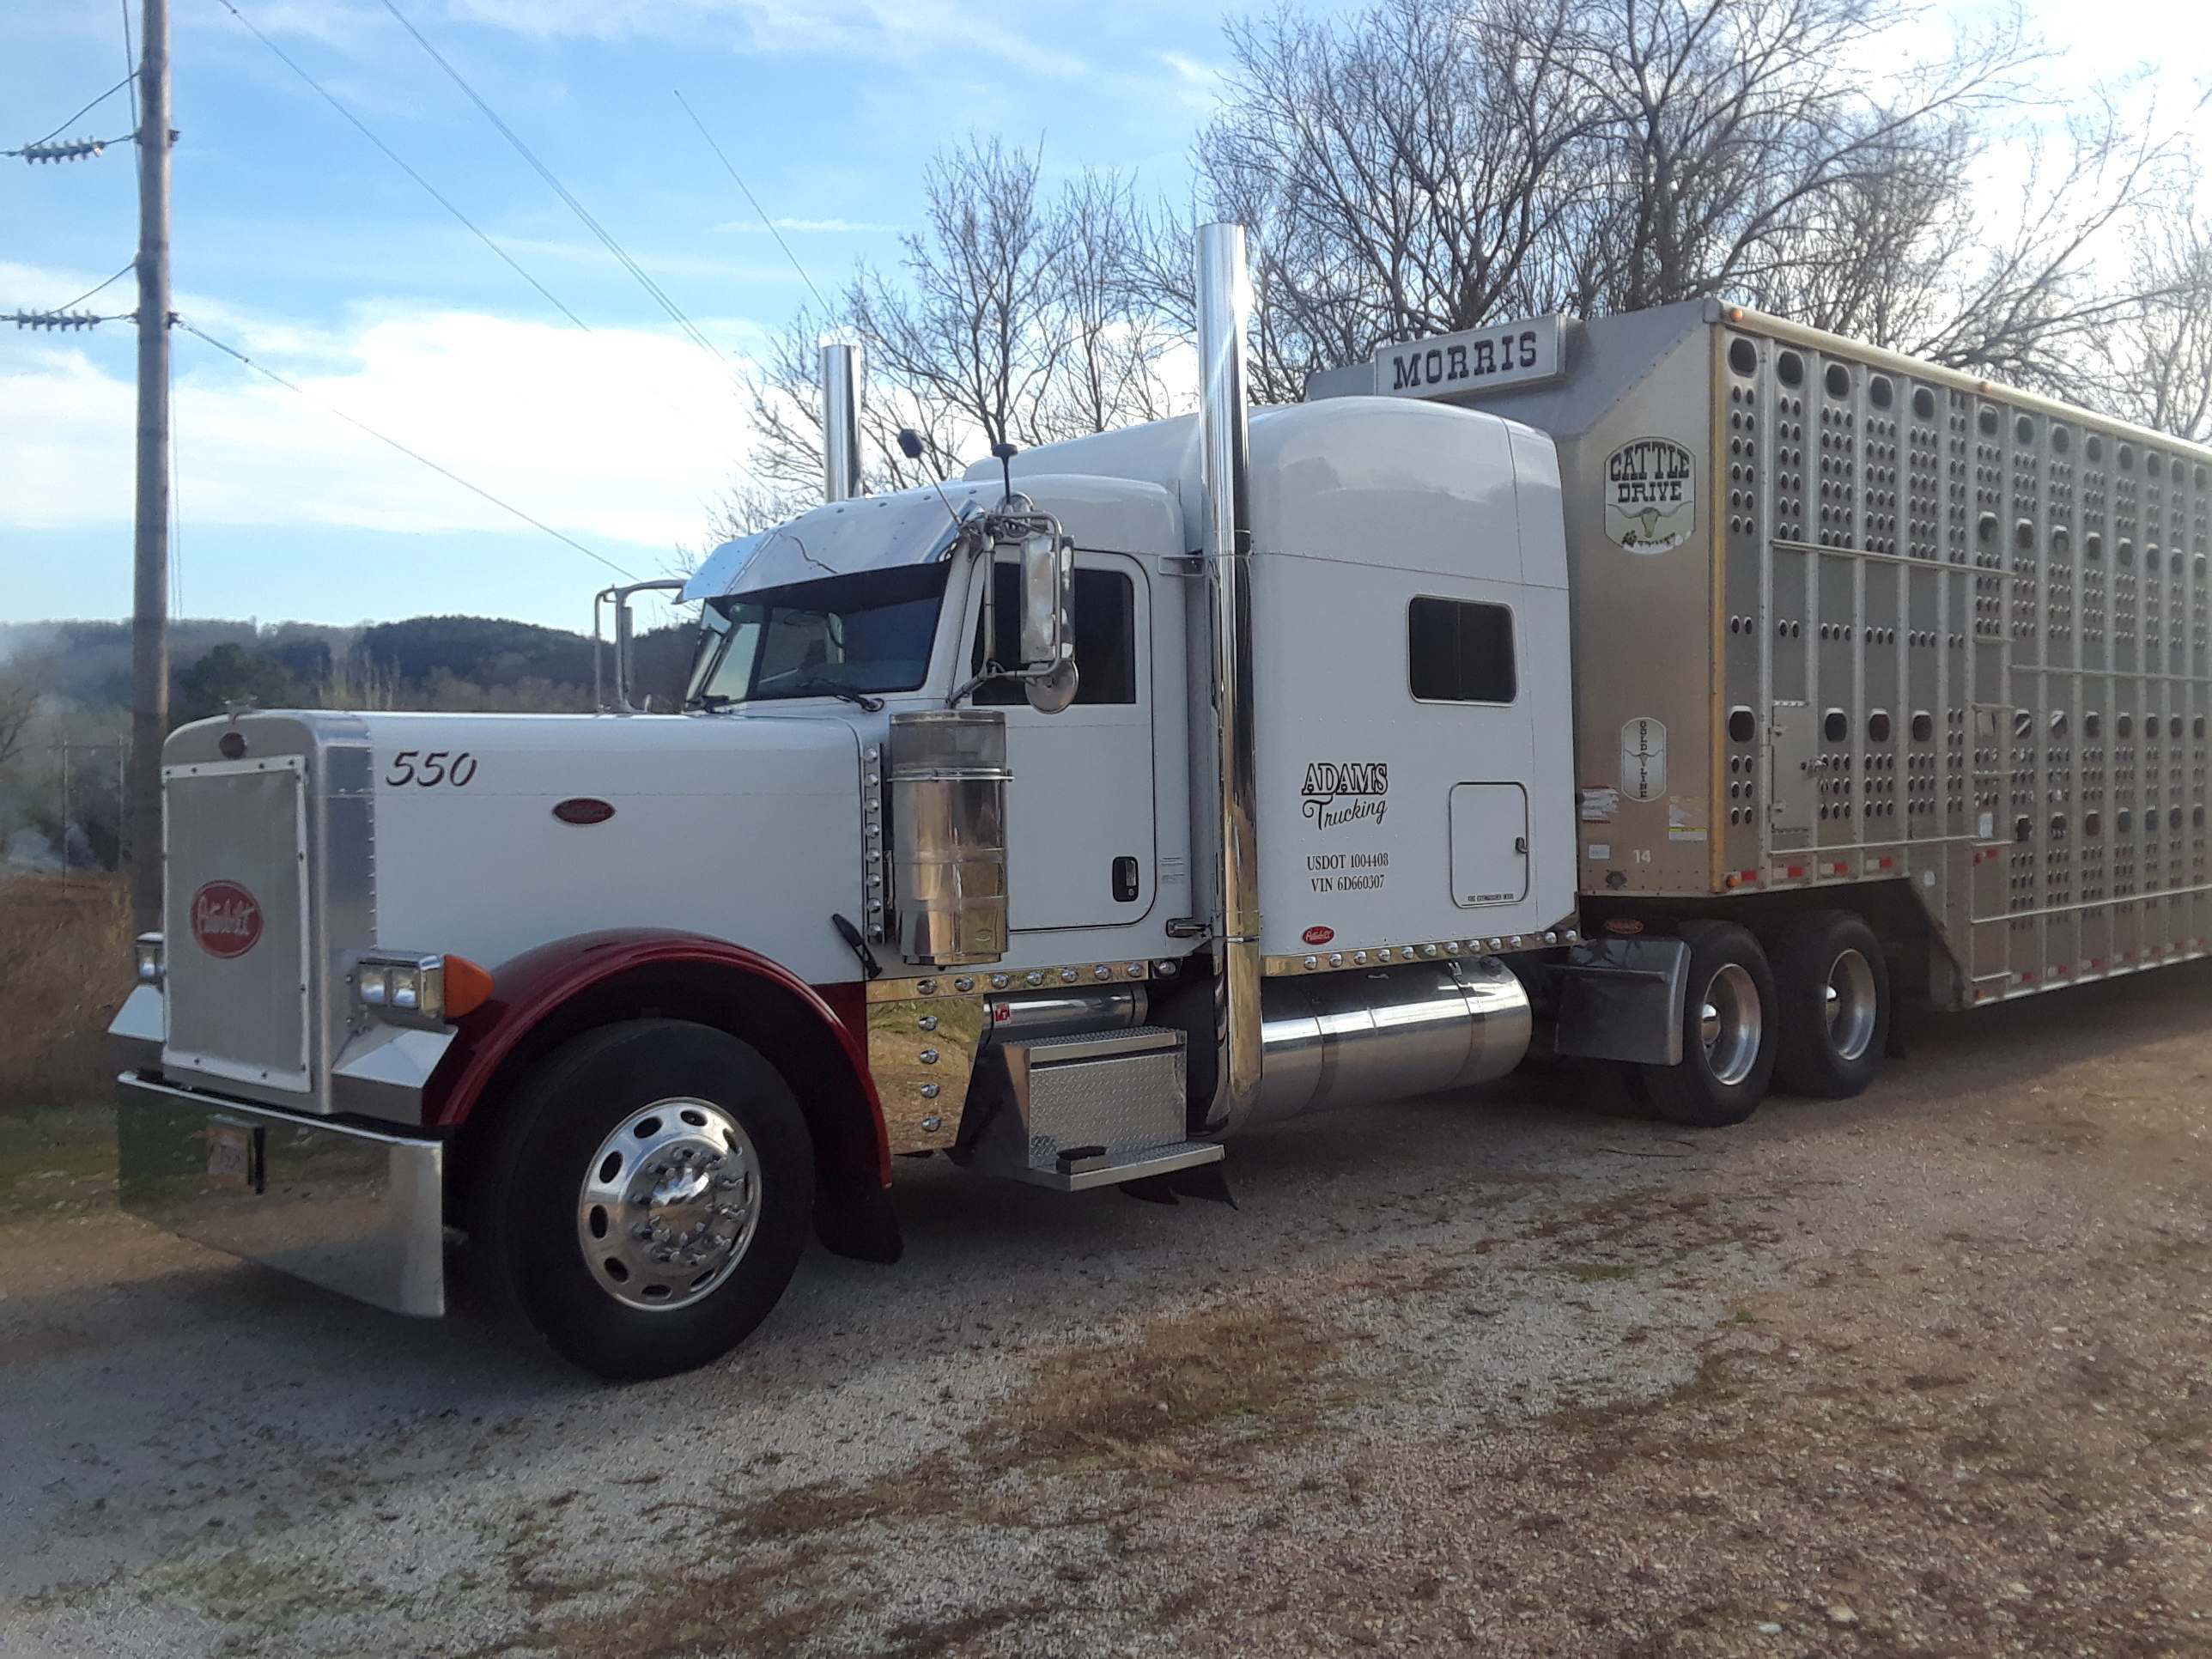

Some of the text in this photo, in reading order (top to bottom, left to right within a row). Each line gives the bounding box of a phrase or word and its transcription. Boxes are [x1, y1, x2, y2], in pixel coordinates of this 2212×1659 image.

[1394, 331, 1536, 389] MORRIS
[1610, 441, 1690, 481] CATTLE
[1618, 481, 1682, 503] DRIVE
[386, 750, 477, 787] 550
[1302, 763, 1388, 795] ADAMS
[1303, 794, 1389, 830] Trucking
[1307, 854, 1346, 871] USDOT
[1633, 849, 1651, 863] 14
[1311, 874, 1384, 892] VIN 6D660307
